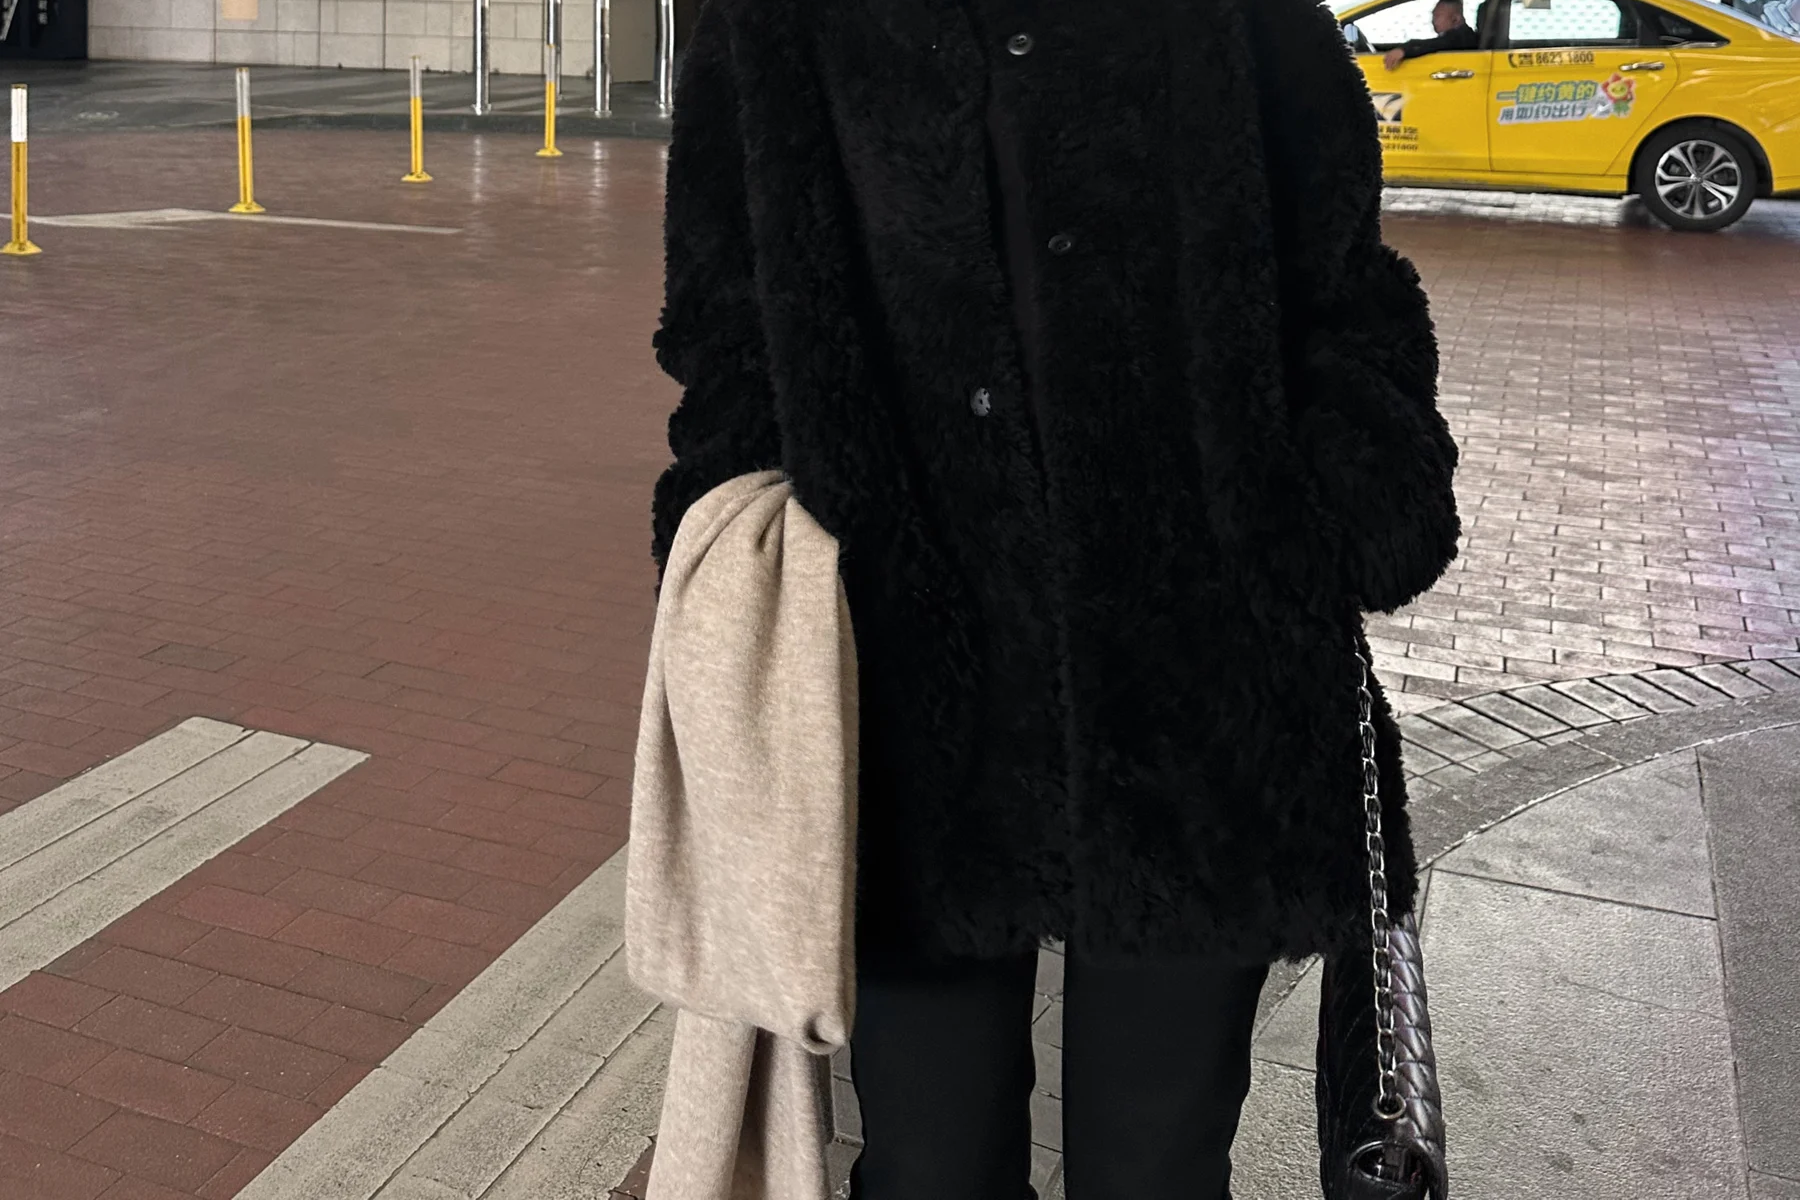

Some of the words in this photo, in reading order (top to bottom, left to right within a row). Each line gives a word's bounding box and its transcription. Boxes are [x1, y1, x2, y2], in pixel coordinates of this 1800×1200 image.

[1496, 80, 1597, 104] 一键约黄的
[1500, 103, 1588, 121] 用如约出行
